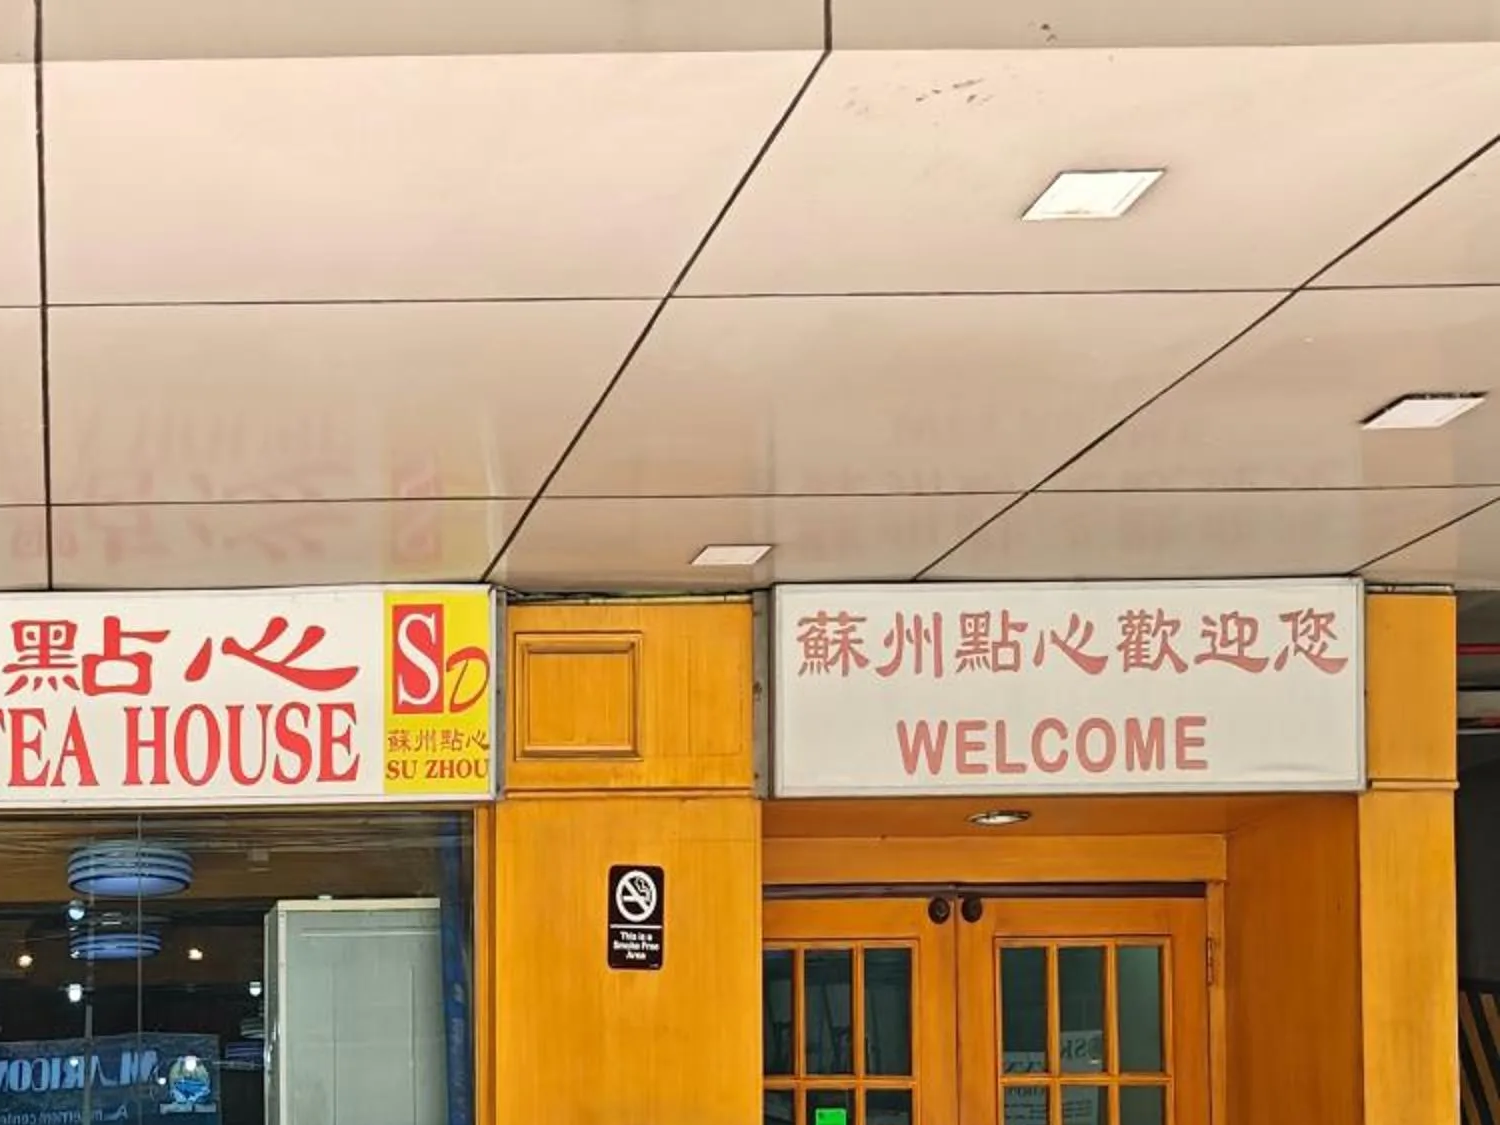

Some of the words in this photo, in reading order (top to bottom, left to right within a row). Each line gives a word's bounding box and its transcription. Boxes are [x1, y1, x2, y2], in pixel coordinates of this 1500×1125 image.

[796, 607, 1349, 679] 蘇州點心歡迎您
[124, 703, 361, 788] HOUSE
[896, 715, 1209, 775] WELCOME
[386, 758, 417, 780] SU
[426, 758, 489, 779] ZHOU
[613, 941, 640, 950] Smoke
[641, 941, 660, 950] Free
[620, 931, 636, 941] This
[638, 932, 645, 941] is
[626, 951, 647, 960] Area
